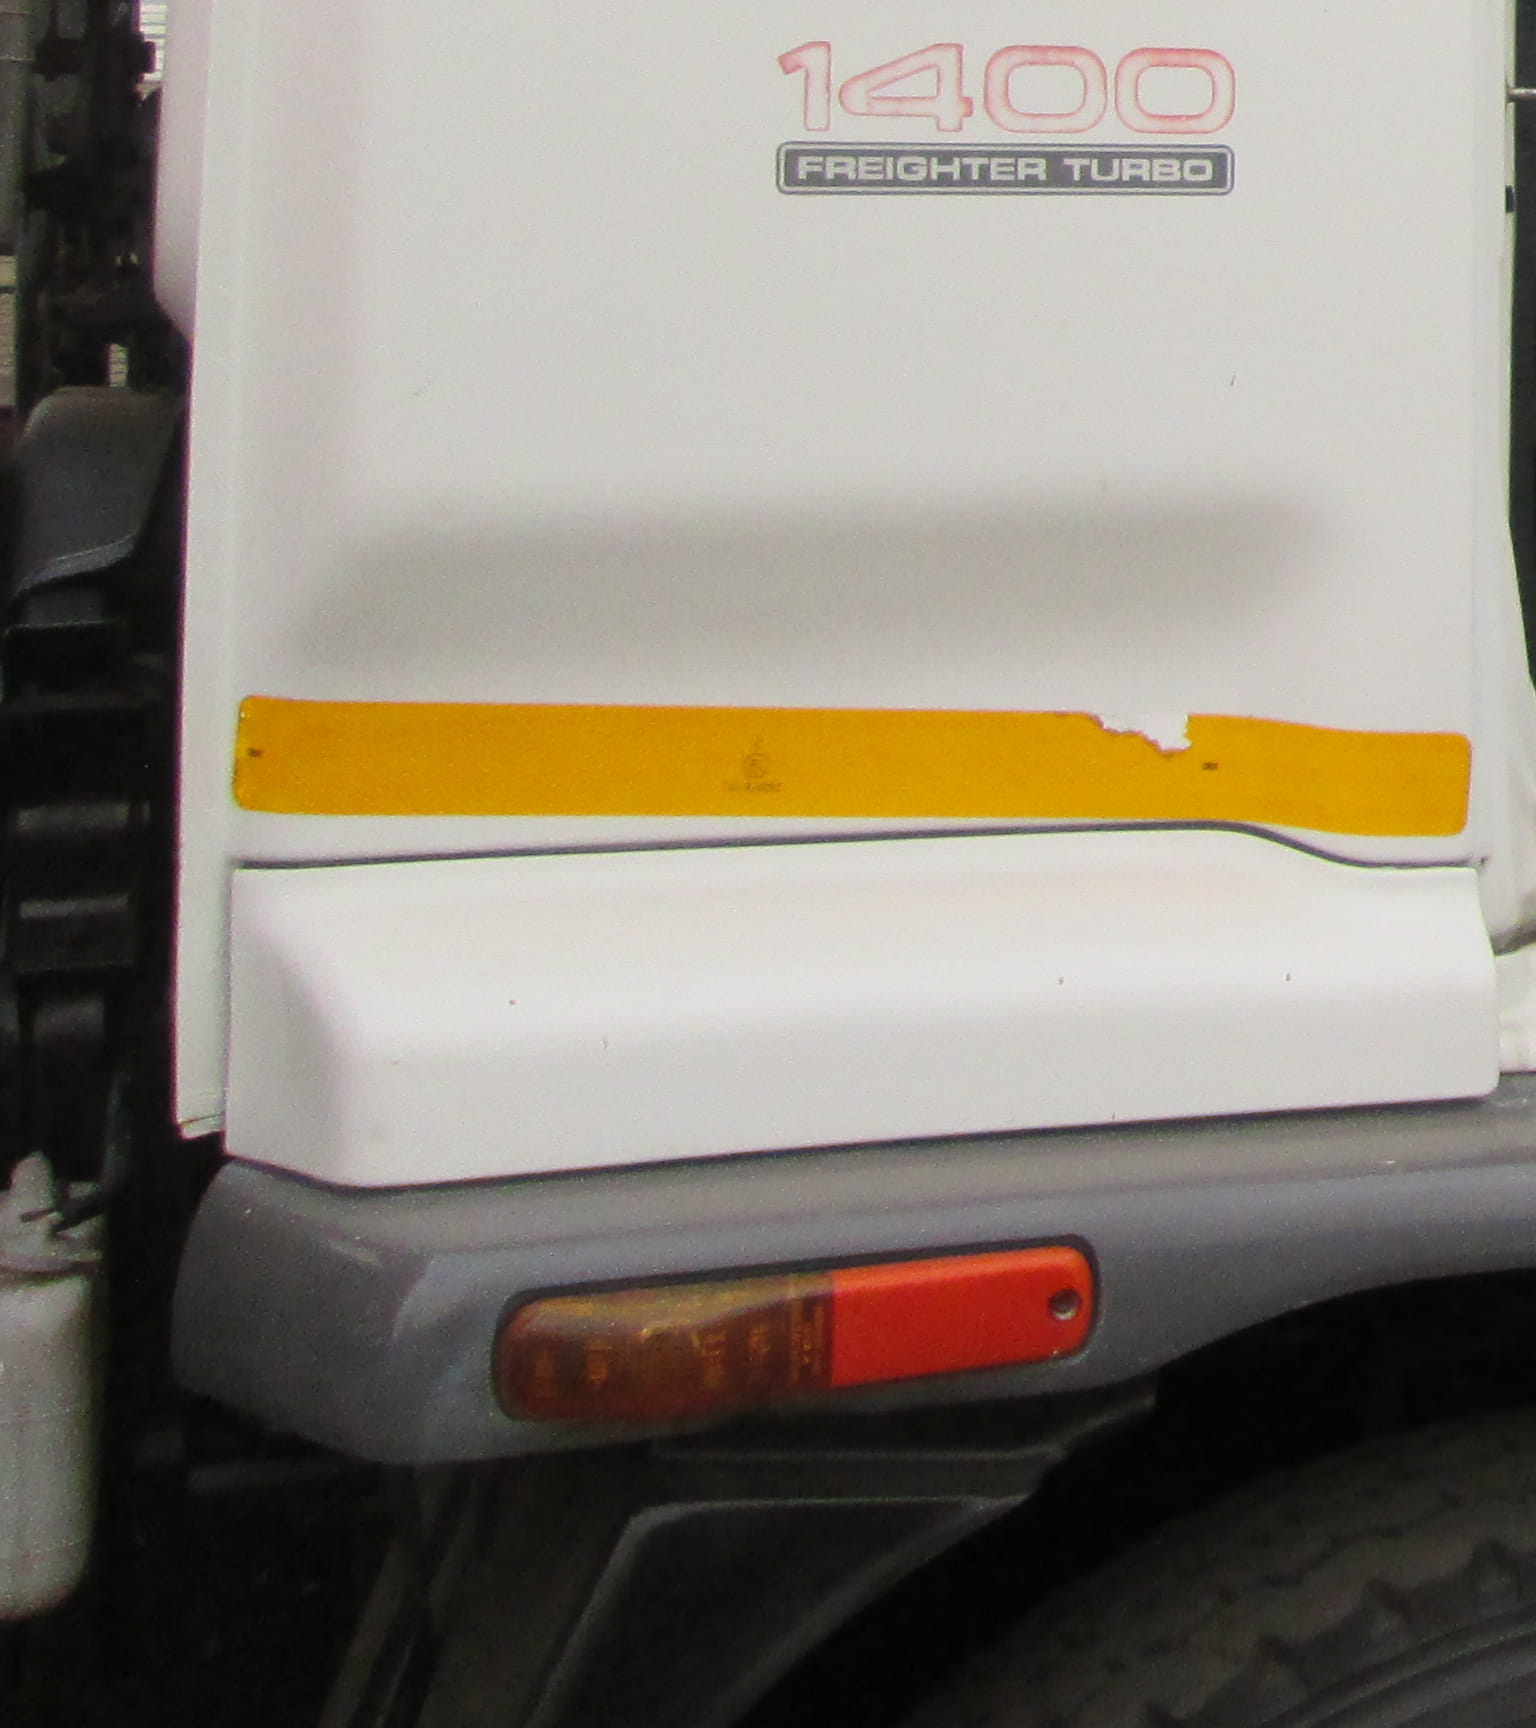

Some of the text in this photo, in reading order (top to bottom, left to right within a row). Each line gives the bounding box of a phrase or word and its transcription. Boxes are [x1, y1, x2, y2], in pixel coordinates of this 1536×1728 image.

[777, 41, 1236, 135] 1400
[797, 155, 1213, 183] FREIGHTER TURBO
